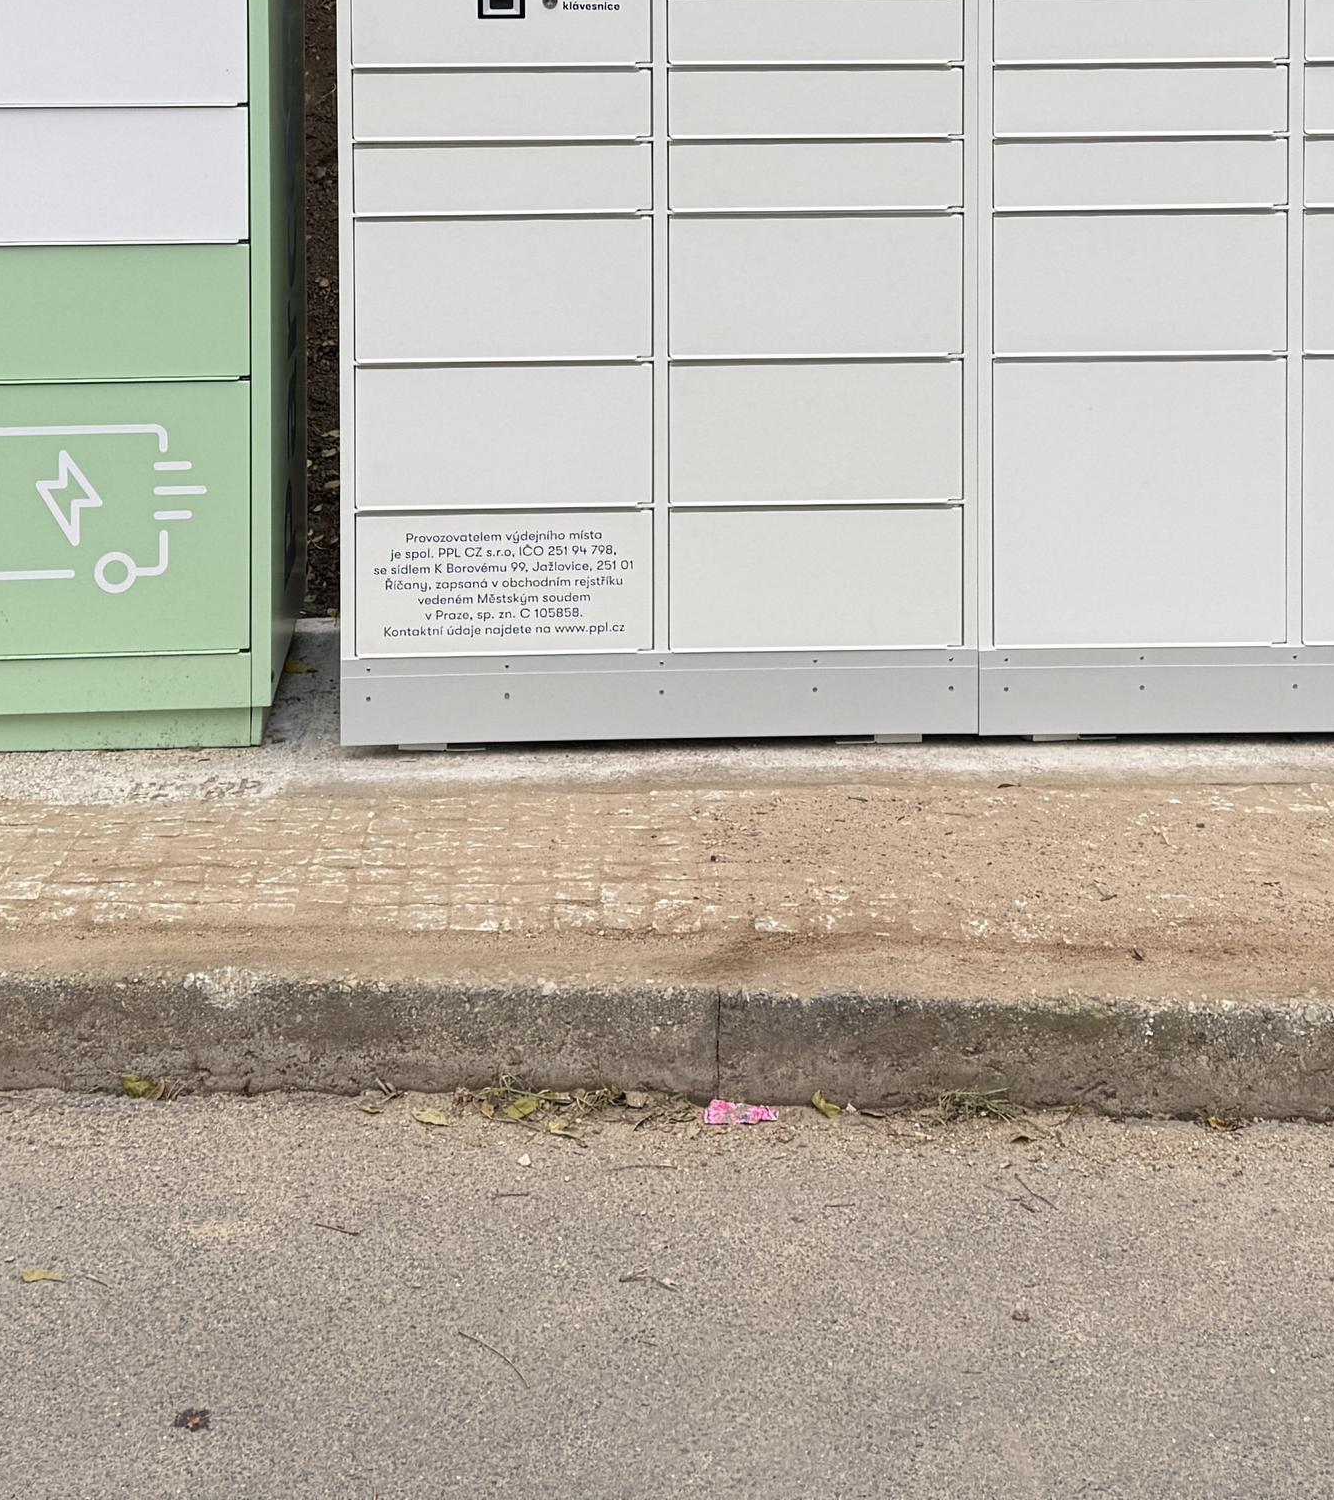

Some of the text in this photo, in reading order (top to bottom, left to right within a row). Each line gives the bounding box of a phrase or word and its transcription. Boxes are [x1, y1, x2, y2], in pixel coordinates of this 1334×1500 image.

[405, 530, 603, 544] Provozovatelem výdejního místa
[389, 549, 402, 562] je
[404, 548, 434, 561] spol.
[438, 547, 462, 558] PPL
[464, 547, 483, 558] CZ
[518, 544, 545, 557] IČO
[547, 545, 568, 556] 251
[571, 545, 588, 555] 94
[590, 544, 618, 556] 798,
[373, 560, 635, 575] se sídlem K Borovému 99, Jažlovice, 251 01
[384, 576, 624, 593] Říčany, zapsaná v obchodním rejstříku
[417, 592, 591, 606] vedeném Městským soudem
[424, 612, 433, 620] v
[476, 611, 495, 622] sp.
[498, 611, 516, 619] zn.
[519, 608, 531, 619] C
[383, 622, 626, 638] Kontaktní údaje najdete na www.ppl.cz
